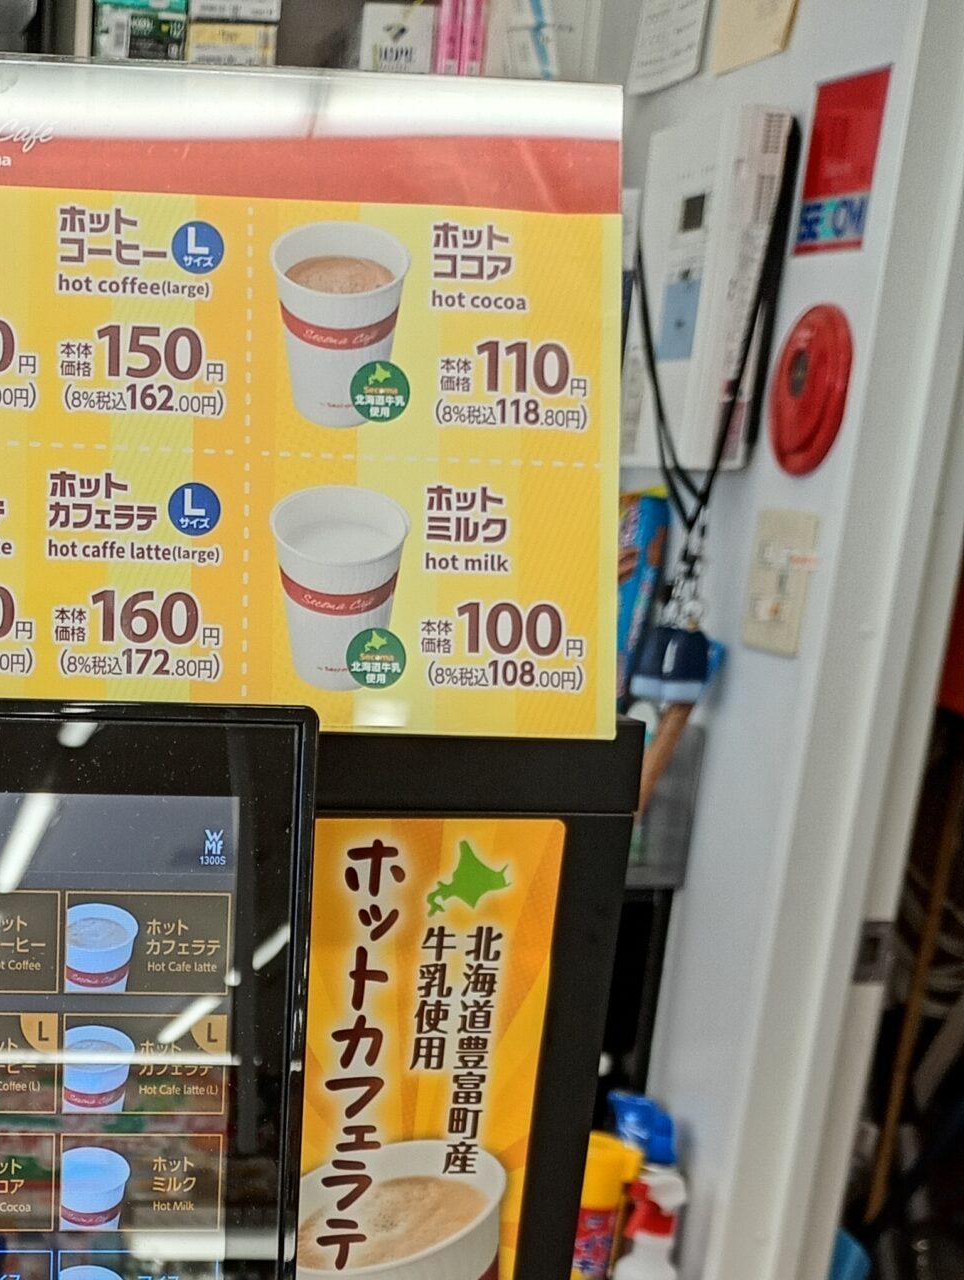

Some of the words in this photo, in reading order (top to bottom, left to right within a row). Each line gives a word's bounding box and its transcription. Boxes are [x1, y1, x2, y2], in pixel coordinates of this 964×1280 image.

[60, 206, 137, 234] ホット
[187, 227, 209, 254] L
[433, 223, 509, 250] ホット
[60, 238, 167, 266] コーヒー
[183, 256, 213, 267] サイズ
[434, 254, 512, 280] ココア
[58, 274, 92, 292] hot
[432, 290, 465, 308] hot
[471, 294, 526, 310] cocoa
[61, 342, 92, 358] 本体
[50, 471, 128, 498] ホット
[184, 489, 205, 516] L
[427, 486, 504, 512] ホット
[49, 502, 157, 530] カフェラテ
[179, 518, 210, 529] サイズ
[426, 517, 507, 543] ミルク
[48, 539, 77, 557] hot
[82, 541, 125, 559] caffe
[425, 553, 459, 570] hot
[464, 554, 509, 572] milk
[200, 856, 226, 866] 1300S
[146, 920, 189, 936] ホット
[146, 939, 221, 956] カフェラテ
[7, 959, 41, 971] Coffee
[147, 961, 165, 972] Hot
[168, 961, 191, 972] Cafe
[194, 962, 217, 972] latte
[410, 926, 457, 1071] 牛乳使用
[38, 1021, 49, 1042] L
[207, 1023, 218, 1042] L
[316, 838, 406, 1270] ホットカフェラテ
[442, 926, 503, 1174] 北海道豊富町産
[139, 1084, 157, 1095] Hot
[159, 1084, 182, 1096] Cafe
[184, 1084, 206, 1096] latte
[153, 1157, 194, 1172] ホット
[152, 1177, 197, 1193] ミルク
[153, 1202, 171, 1212] Hot
[173, 1201, 194, 1212] Milk
